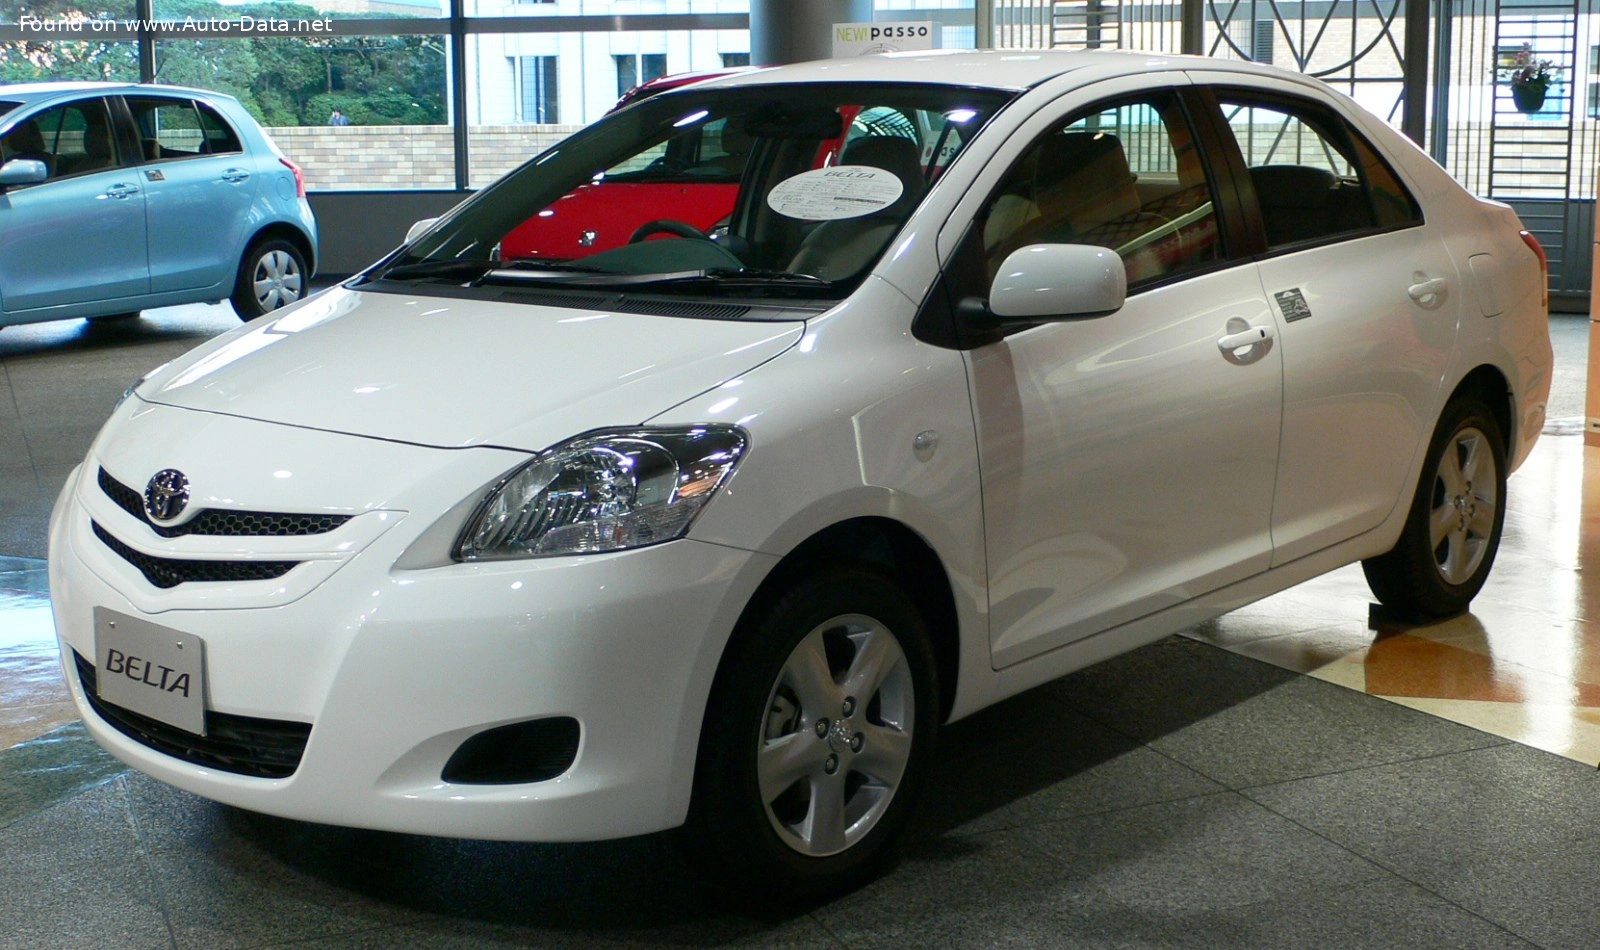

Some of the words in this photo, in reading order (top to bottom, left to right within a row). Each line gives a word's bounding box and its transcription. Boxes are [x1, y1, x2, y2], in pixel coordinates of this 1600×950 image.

[837, 27, 867, 42] NEW!
[871, 26, 928, 40] passo
[824, 171, 876, 179] BELTA
[106, 648, 190, 698] BELTA
